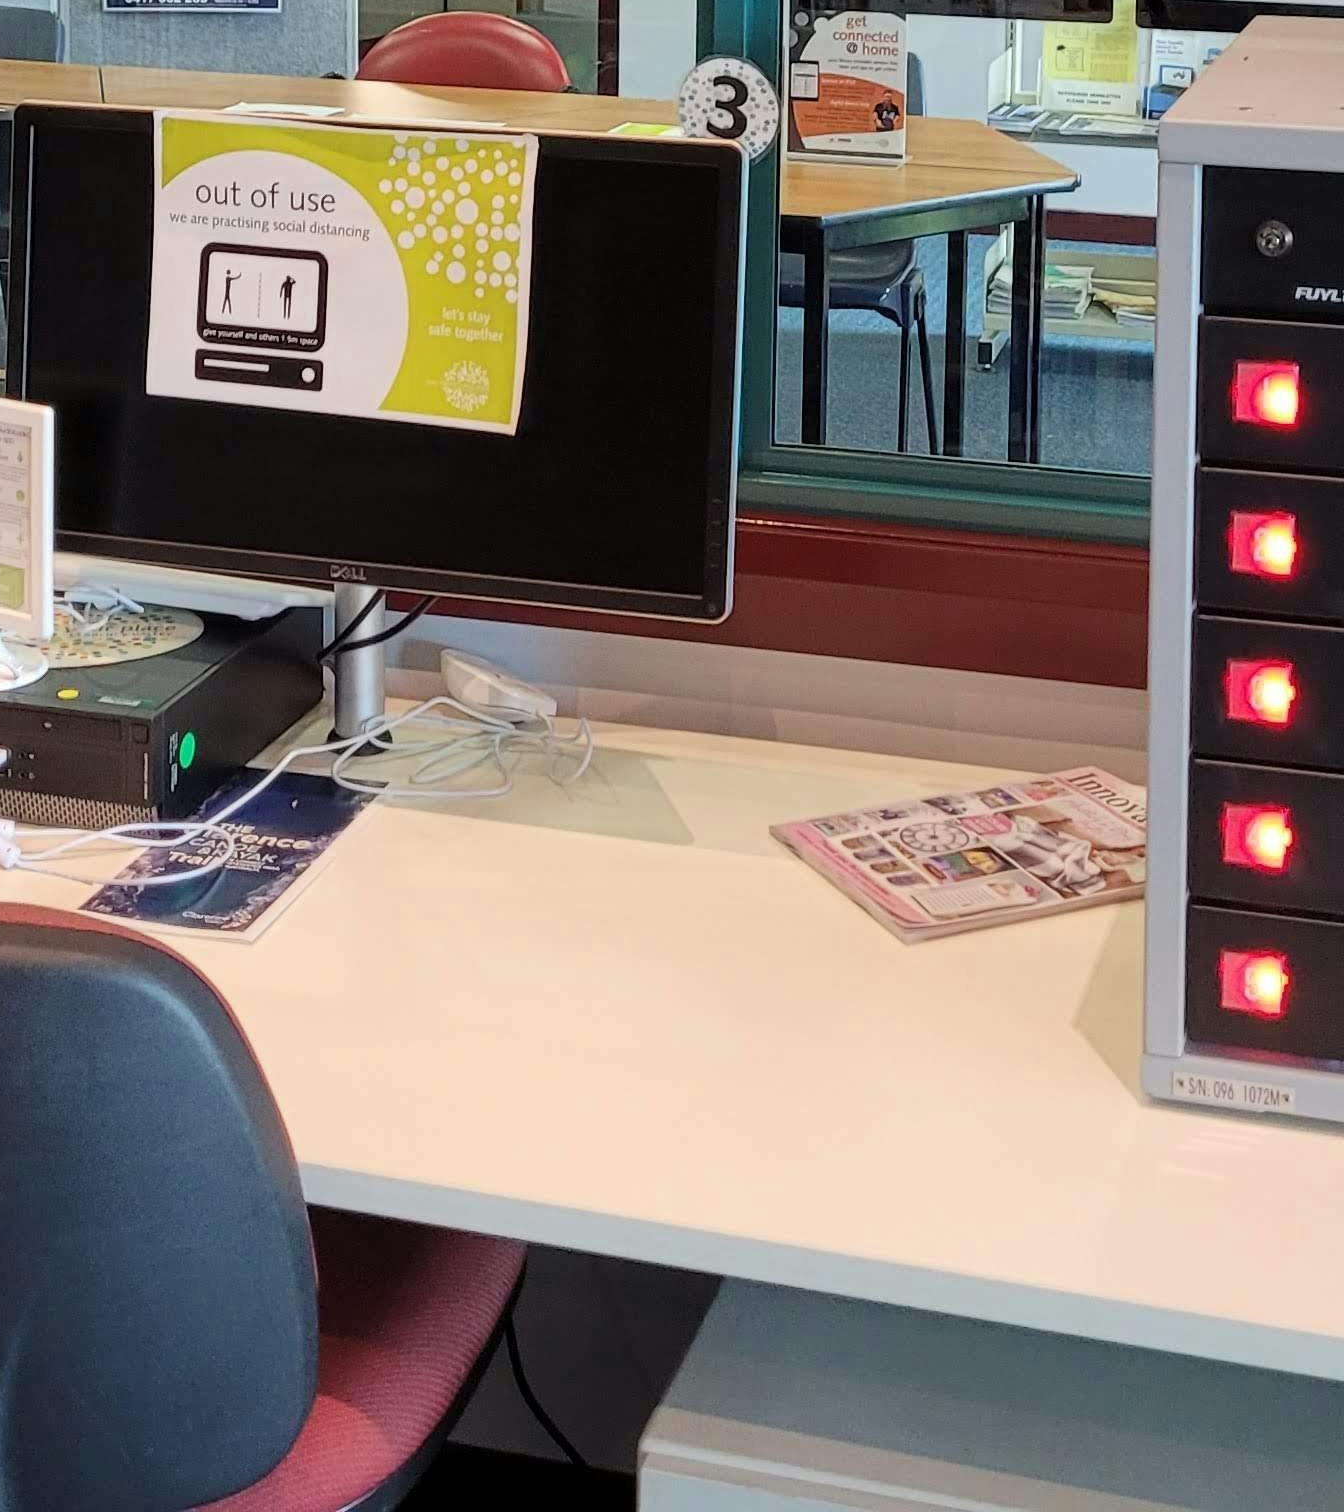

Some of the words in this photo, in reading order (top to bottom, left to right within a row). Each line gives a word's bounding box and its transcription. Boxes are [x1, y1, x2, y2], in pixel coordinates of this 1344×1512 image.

[846, 16, 867, 29] get
[833, 29, 899, 44] connected
[862, 43, 899, 57] home
[707, 75, 749, 139] 3
[196, 181, 241, 207] out
[251, 182, 280, 209] of
[290, 191, 336, 214] use
[169, 212, 188, 223] we
[191, 215, 209, 226] are
[212, 215, 269, 233] practising
[273, 218, 305, 233] social
[309, 220, 370, 241] distancing
[468, 310, 491, 326] stay
[331, 564, 367, 580] DELL
[1188, 1077, 1212, 1098] S/N:
[1243, 1084, 1281, 1106] 1072M
